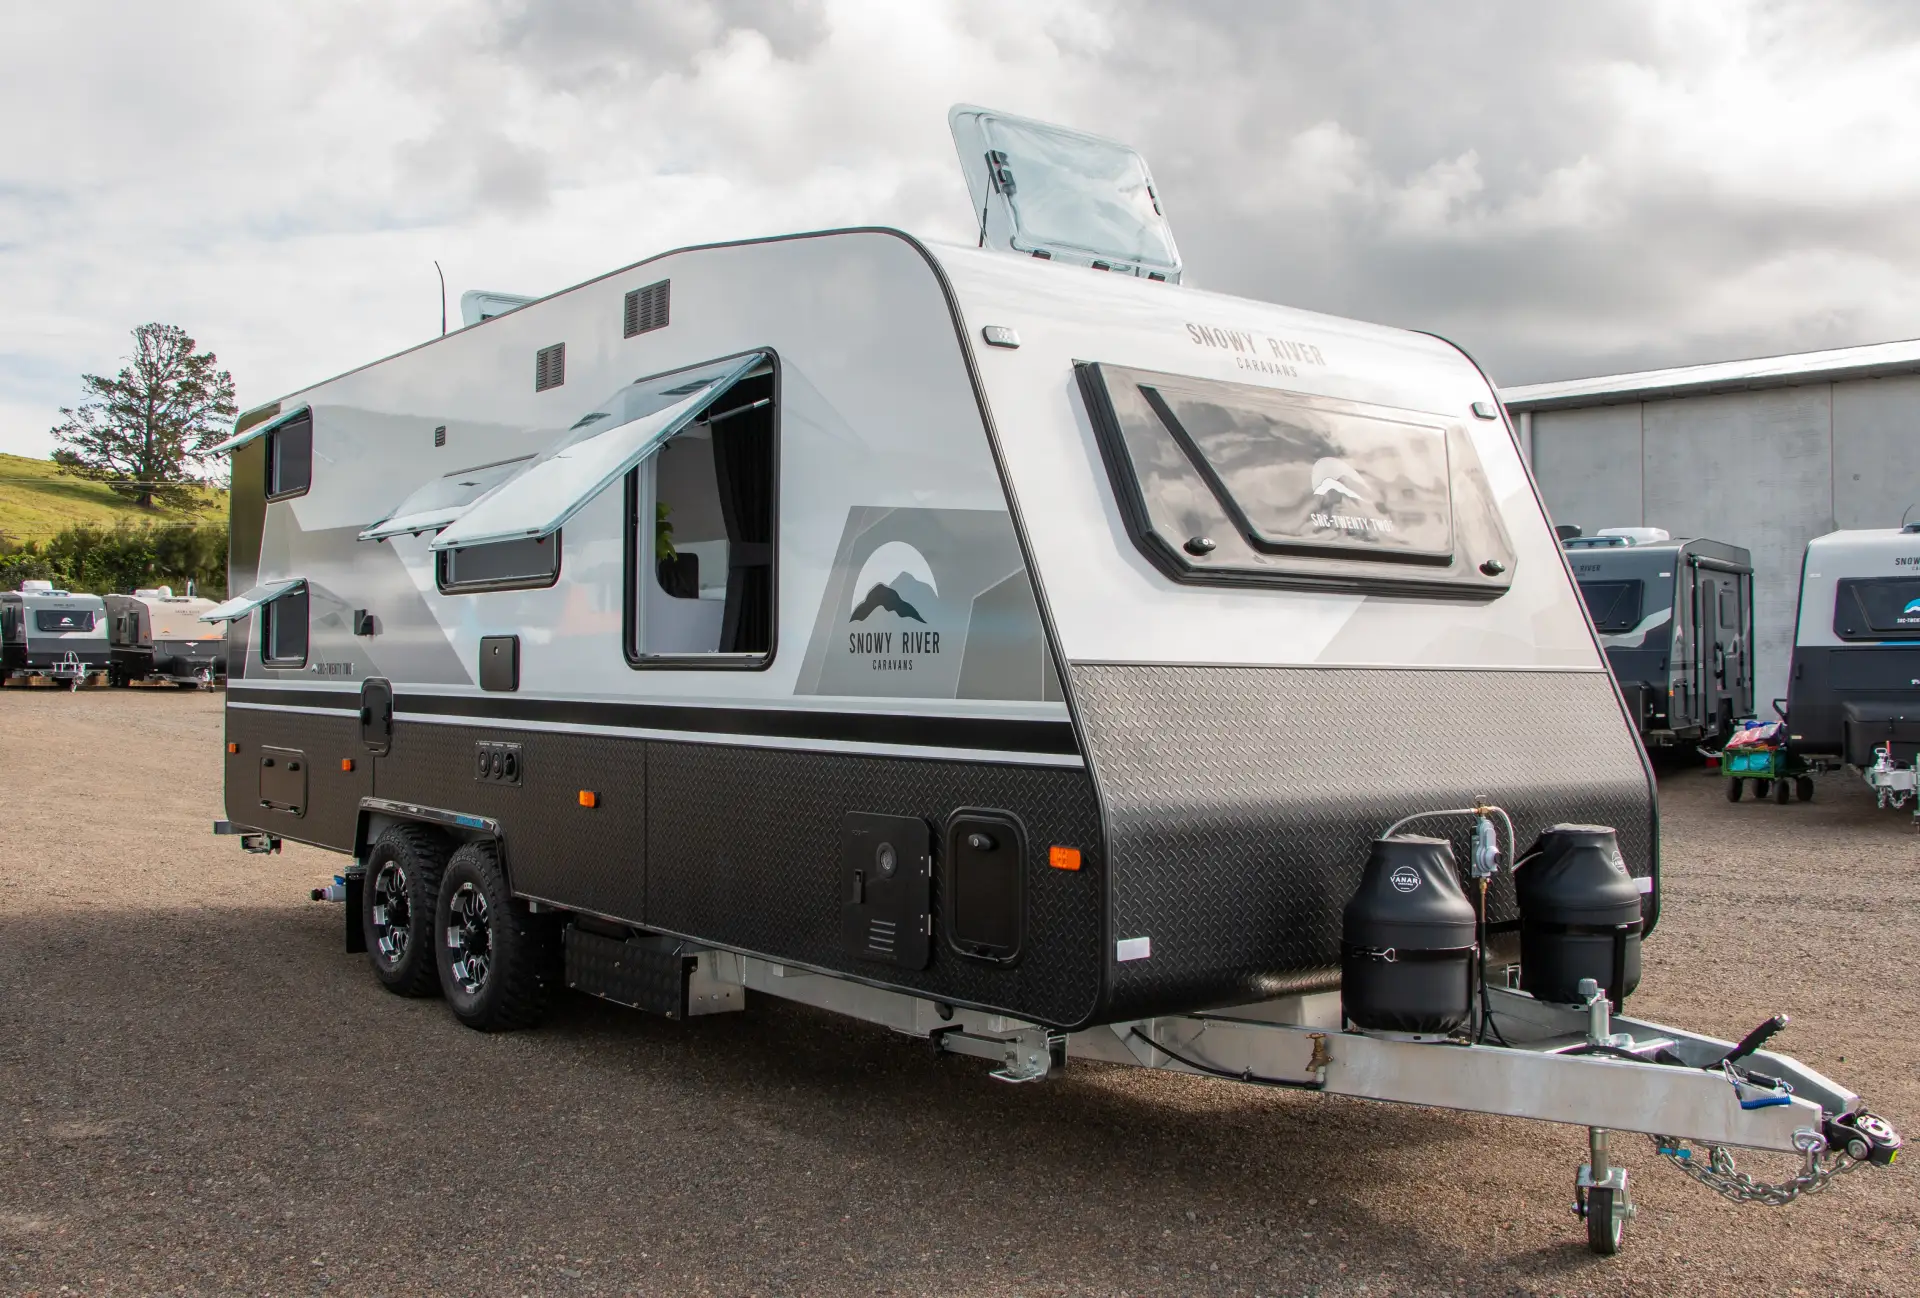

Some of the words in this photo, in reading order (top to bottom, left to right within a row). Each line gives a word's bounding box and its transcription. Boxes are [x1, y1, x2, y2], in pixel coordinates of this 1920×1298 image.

[1185, 323, 1257, 354] SNOWY
[1266, 338, 1327, 366] RIVER
[1236, 357, 1298, 378] CARAVANS
[1310, 513, 1369, 531] SRC-TWENTY
[1580, 564, 1601, 572] RIVER
[849, 632, 892, 654] SNOWY
[902, 631, 940, 654] RIVER
[872, 659, 913, 671] CARAVANS
